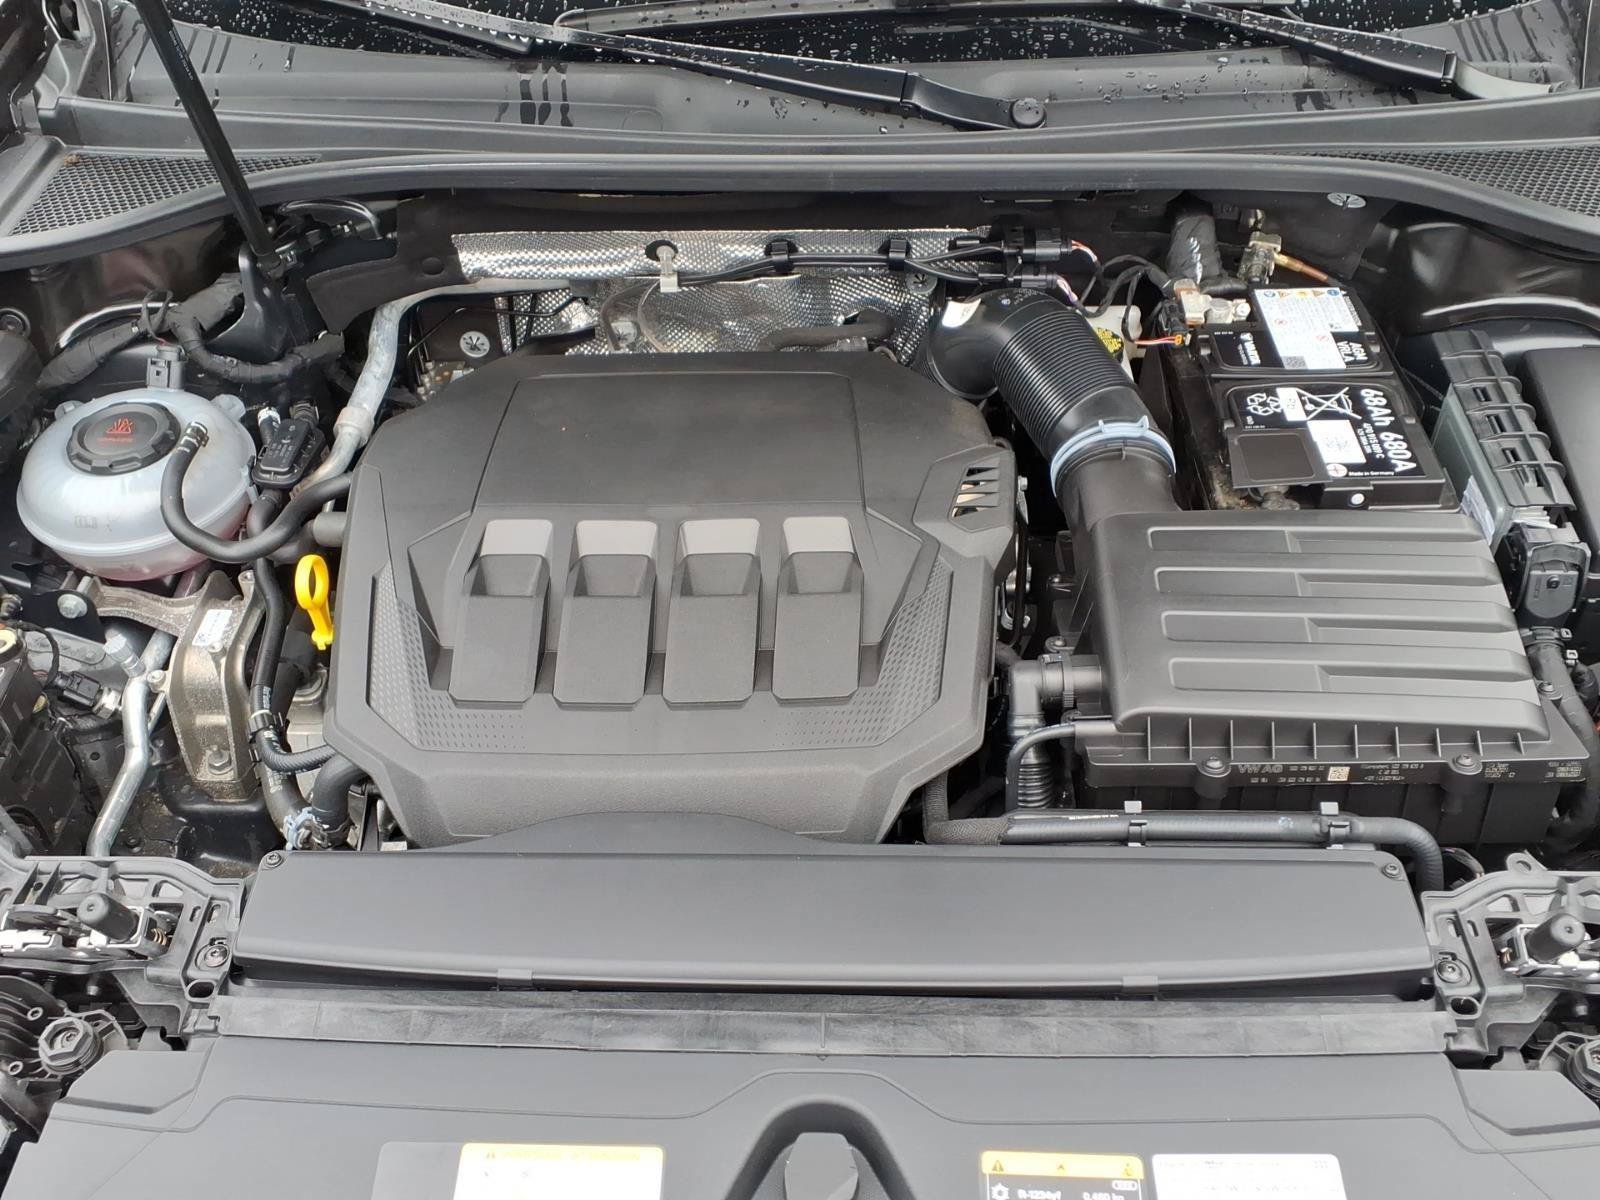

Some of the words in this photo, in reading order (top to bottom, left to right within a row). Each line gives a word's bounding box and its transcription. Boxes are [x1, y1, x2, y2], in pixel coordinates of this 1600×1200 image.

[1336, 340, 1355, 362] VRLA
[1349, 341, 1369, 361] AGM
[1360, 388, 1395, 426] 68Ah
[1380, 432, 1417, 473] 680A
[1238, 764, 1261, 774] VW
[1261, 764, 1284, 773] AG
